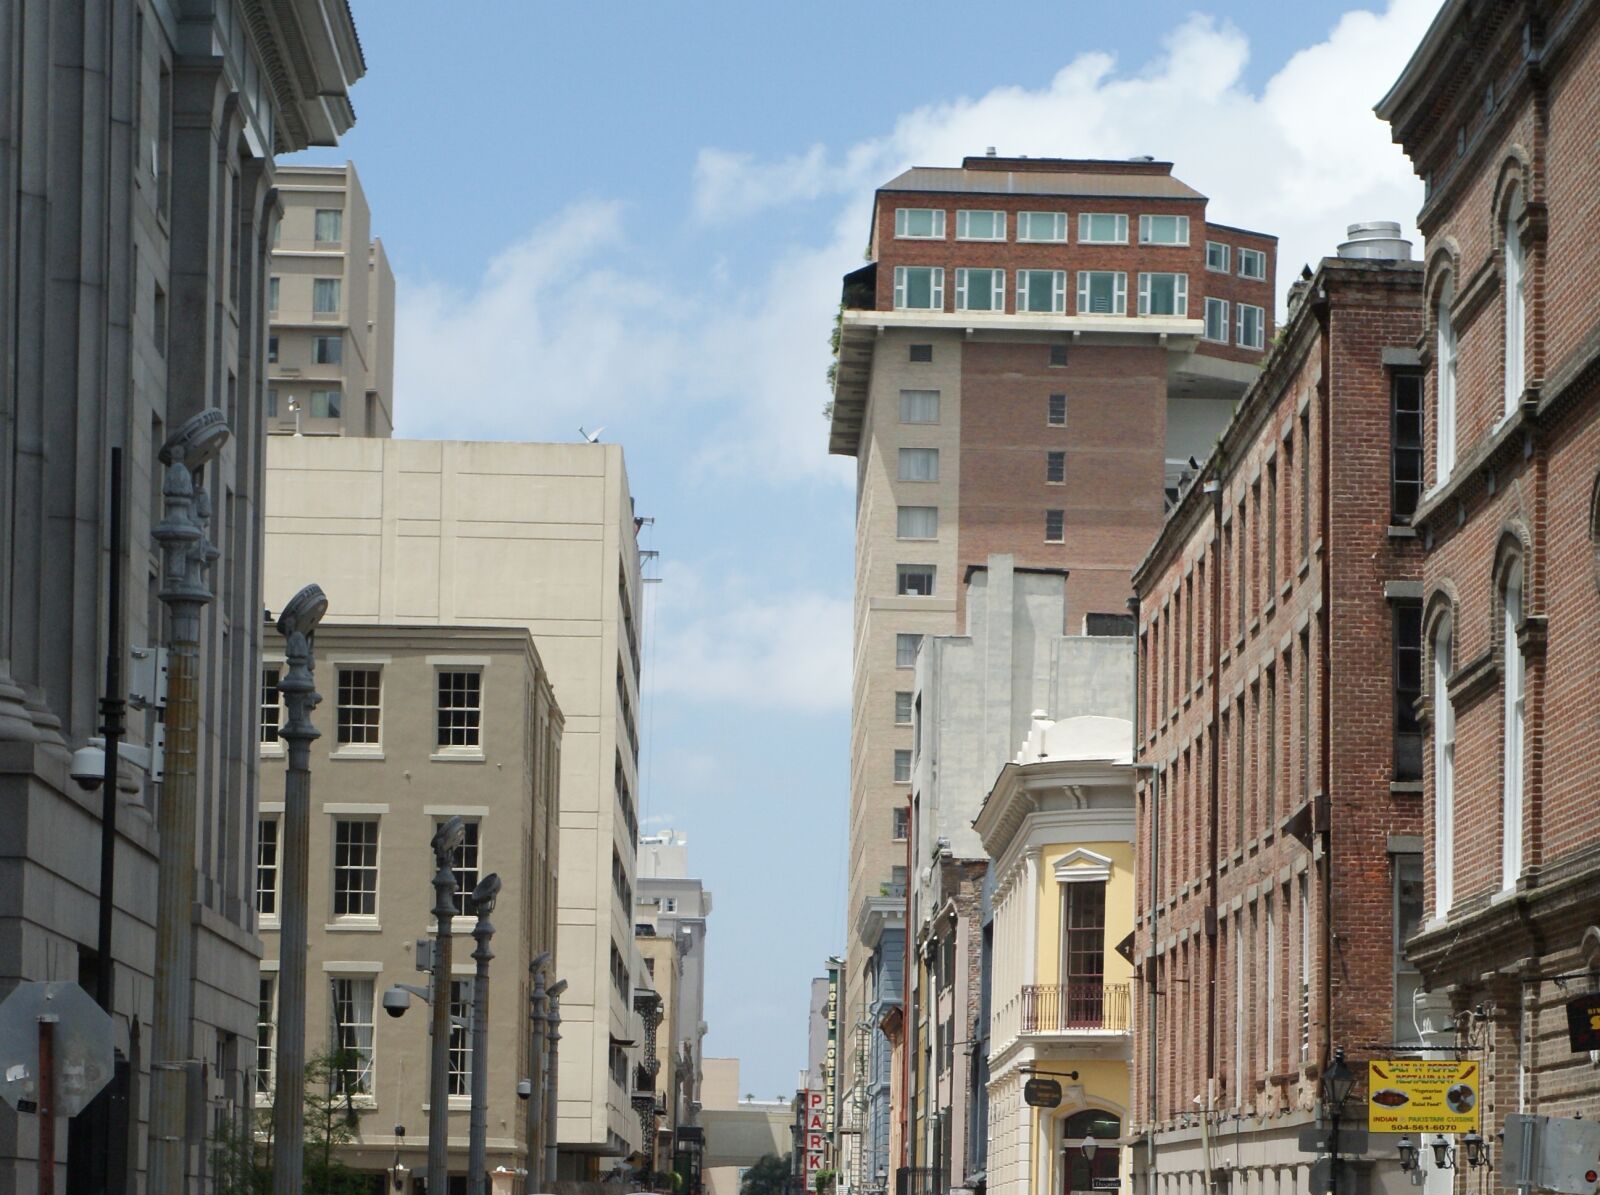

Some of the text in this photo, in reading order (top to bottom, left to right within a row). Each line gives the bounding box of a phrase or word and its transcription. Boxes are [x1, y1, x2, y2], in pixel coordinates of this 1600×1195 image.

[826, 983, 837, 1132] HOTEL MONTELEONE
[1396, 1075, 1455, 1084] RESTAURANT
[810, 1094, 822, 1169] PARK
